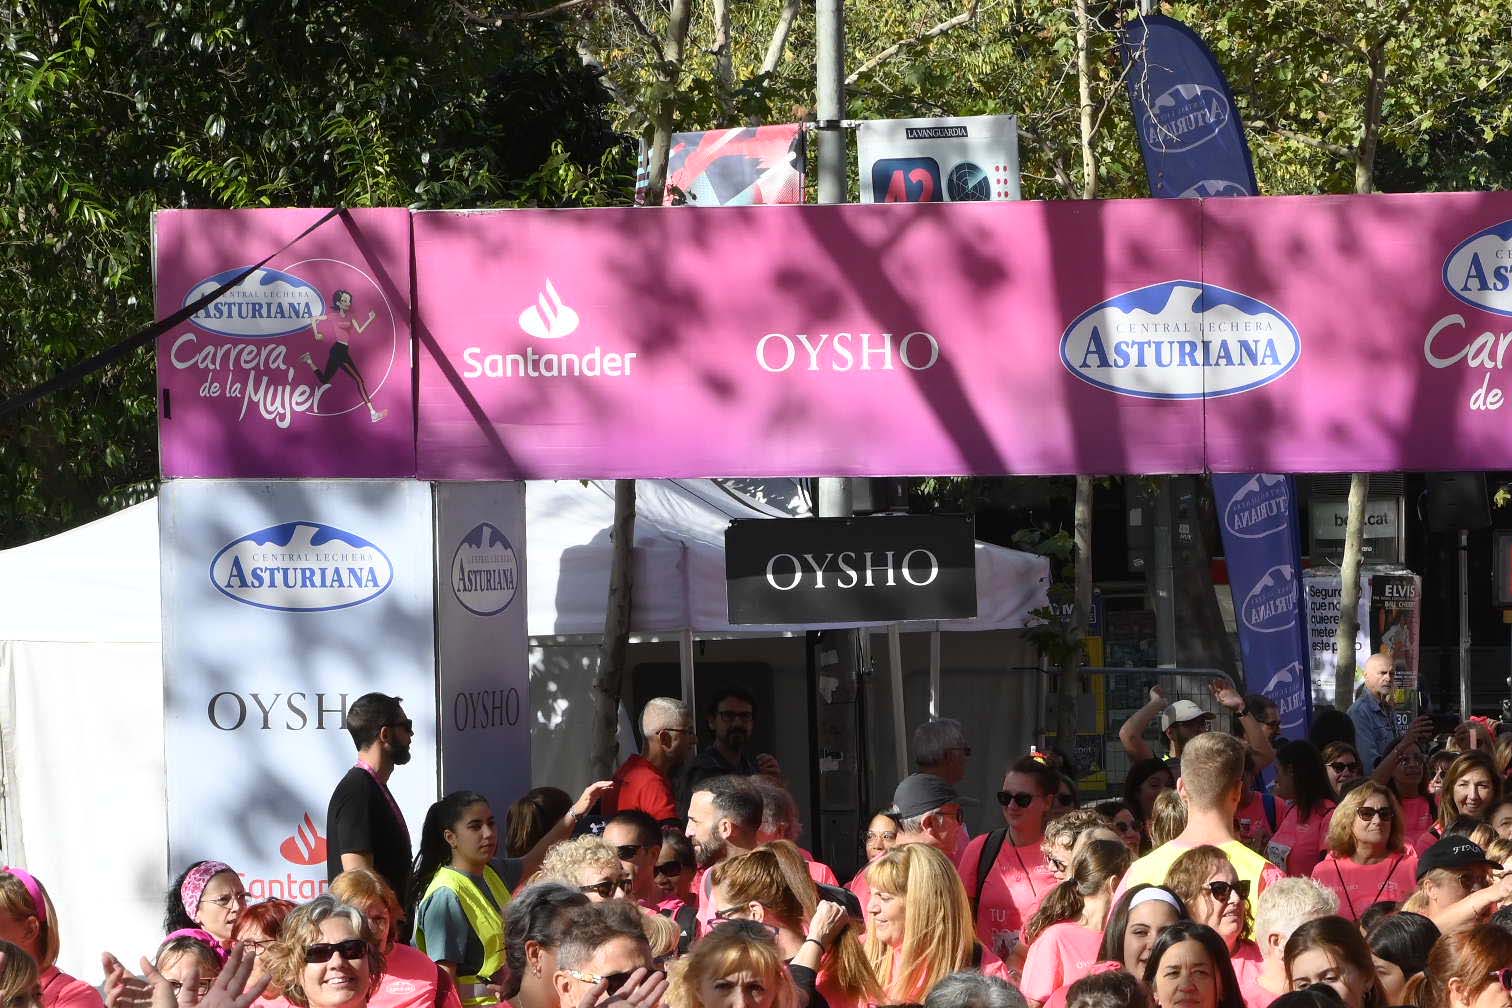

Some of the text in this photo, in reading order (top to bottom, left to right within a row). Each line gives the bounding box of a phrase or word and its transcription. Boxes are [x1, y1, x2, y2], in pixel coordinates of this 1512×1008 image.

[1116, 320, 1274, 333] CENTRAL LECHERA
[170, 331, 288, 371] Carrera
[463, 346, 638, 378] Santander
[756, 331, 940, 373] OYSHO
[1079, 325, 1281, 370] ASTURIANA
[199, 366, 332, 429] de la Mujer
[1469, 370, 1504, 411] de
[225, 555, 381, 589] ASTURIANA
[252, 552, 311, 562] CENTRAL
[457, 554, 515, 593] ASTURIANA
[766, 549, 939, 591] OYSHO
[1384, 584, 1416, 597] ELVIS
[1311, 602, 1326, 614] que
[1311, 612, 1342, 626] quiere
[1312, 640, 1330, 652] este
[454, 688, 520, 732] OYSHO
[1396, 714, 1408, 725] 30
[990, 908, 1006, 922] TU
